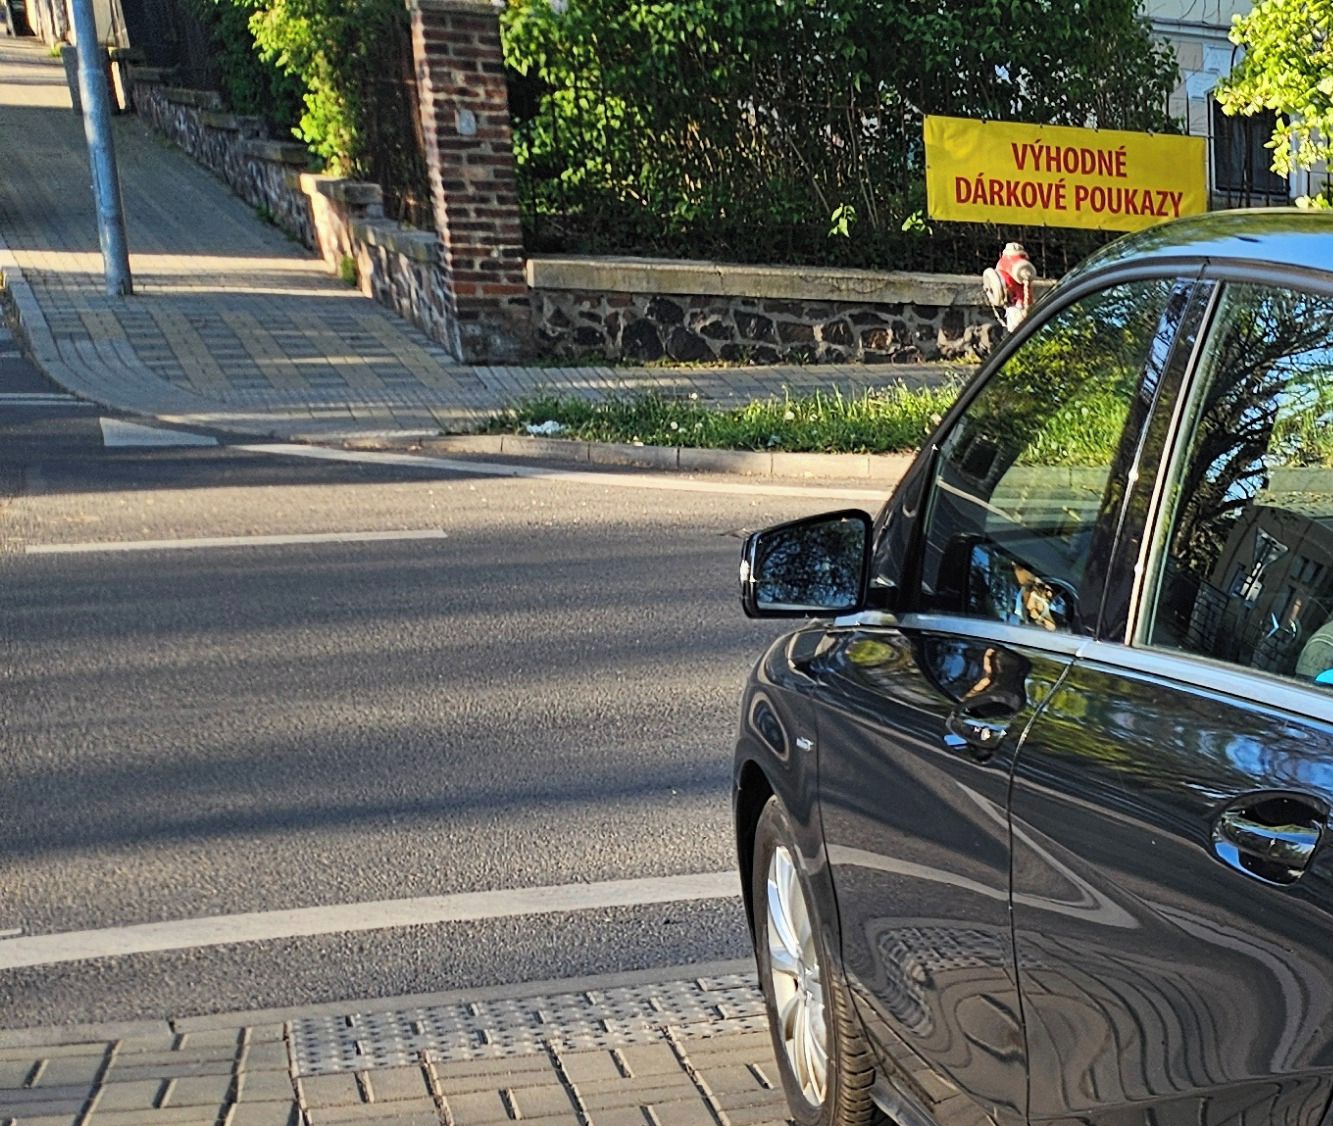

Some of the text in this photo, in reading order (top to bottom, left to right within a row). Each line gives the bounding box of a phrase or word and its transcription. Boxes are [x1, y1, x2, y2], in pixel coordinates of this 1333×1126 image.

[1012, 139, 1127, 178] VÝHODNÉ
[955, 172, 1183, 217] DÁRKOVÉ POUKAZY
